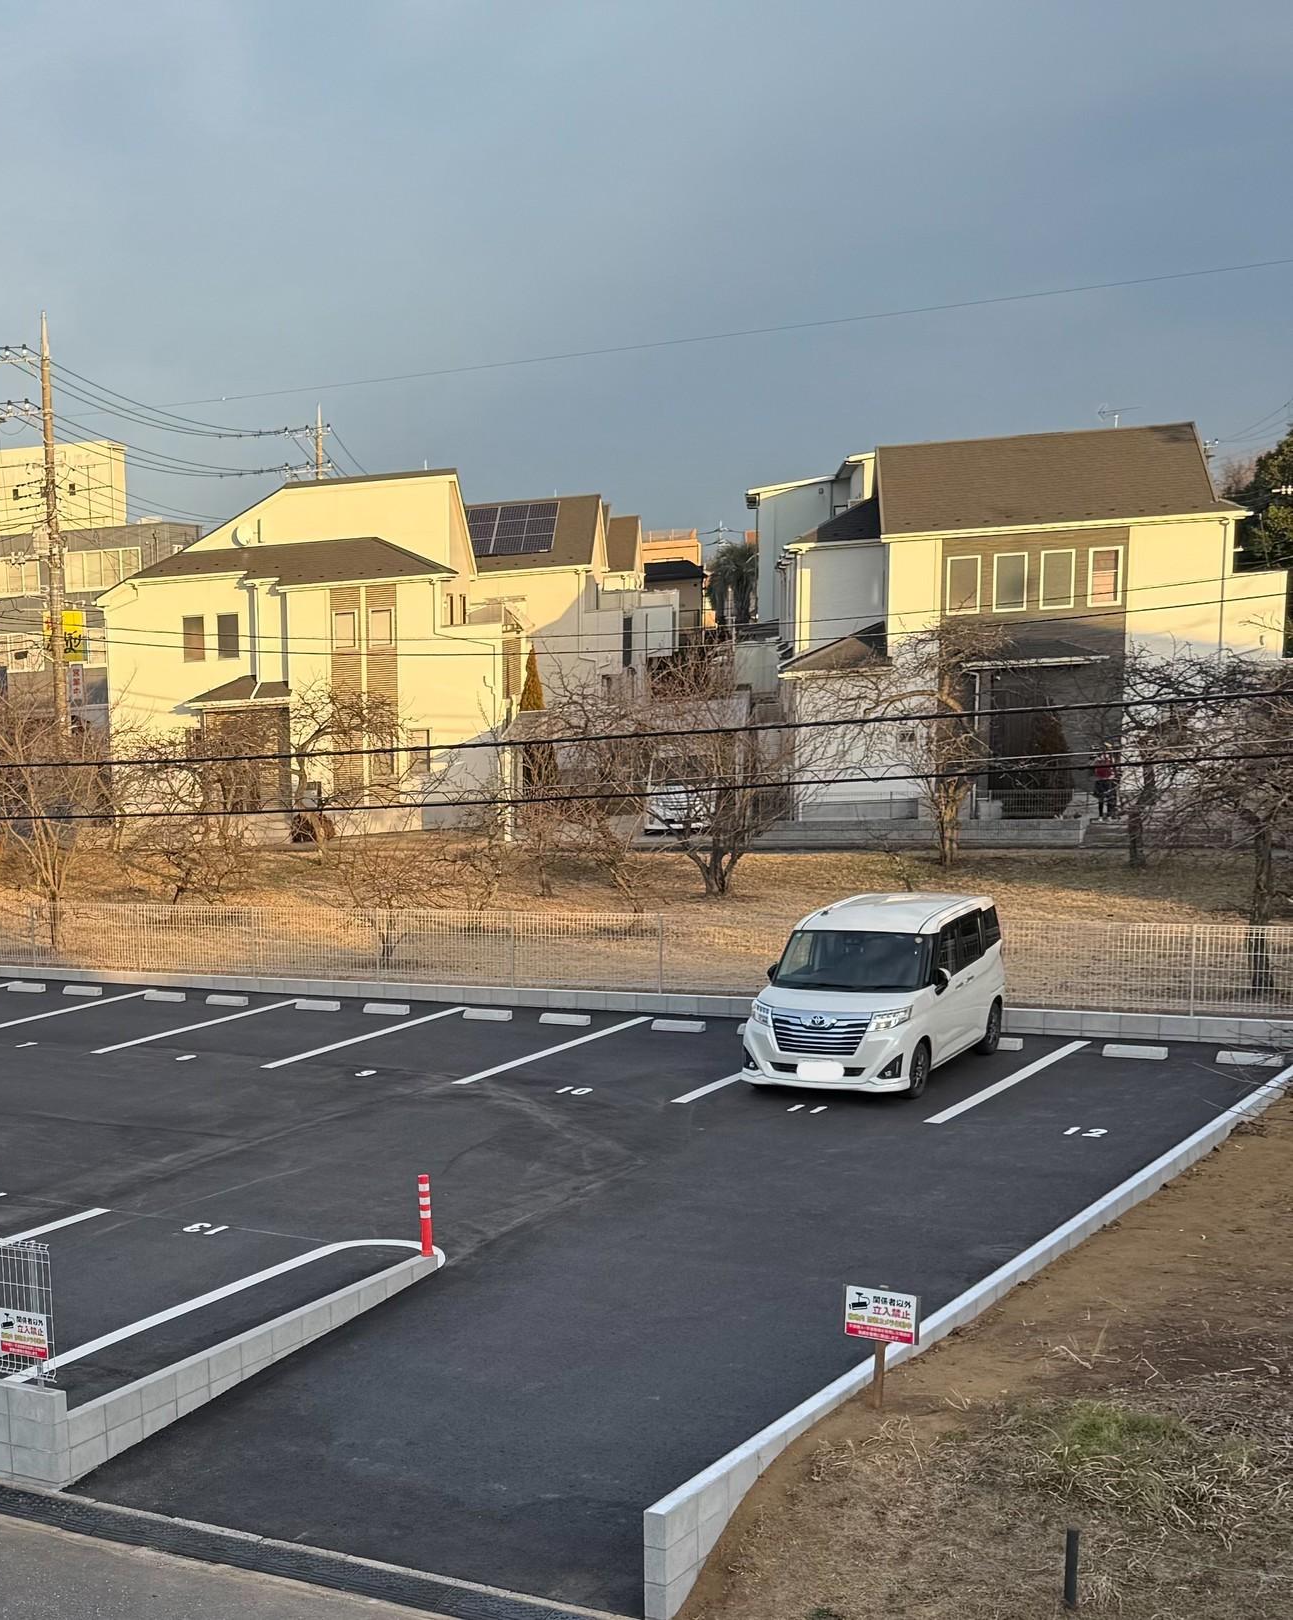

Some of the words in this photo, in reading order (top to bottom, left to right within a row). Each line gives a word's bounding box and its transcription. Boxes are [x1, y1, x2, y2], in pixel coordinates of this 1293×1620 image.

[555, 1086, 594, 1095] 10
[786, 1104, 828, 1114] 11
[1063, 1126, 1108, 1138] 12
[182, 1222, 230, 1235] 13
[872, 1296, 912, 1309] 関係者以外
[872, 1306, 911, 1320] 立入禁止
[17, 1325, 44, 1337] 立入禁止
